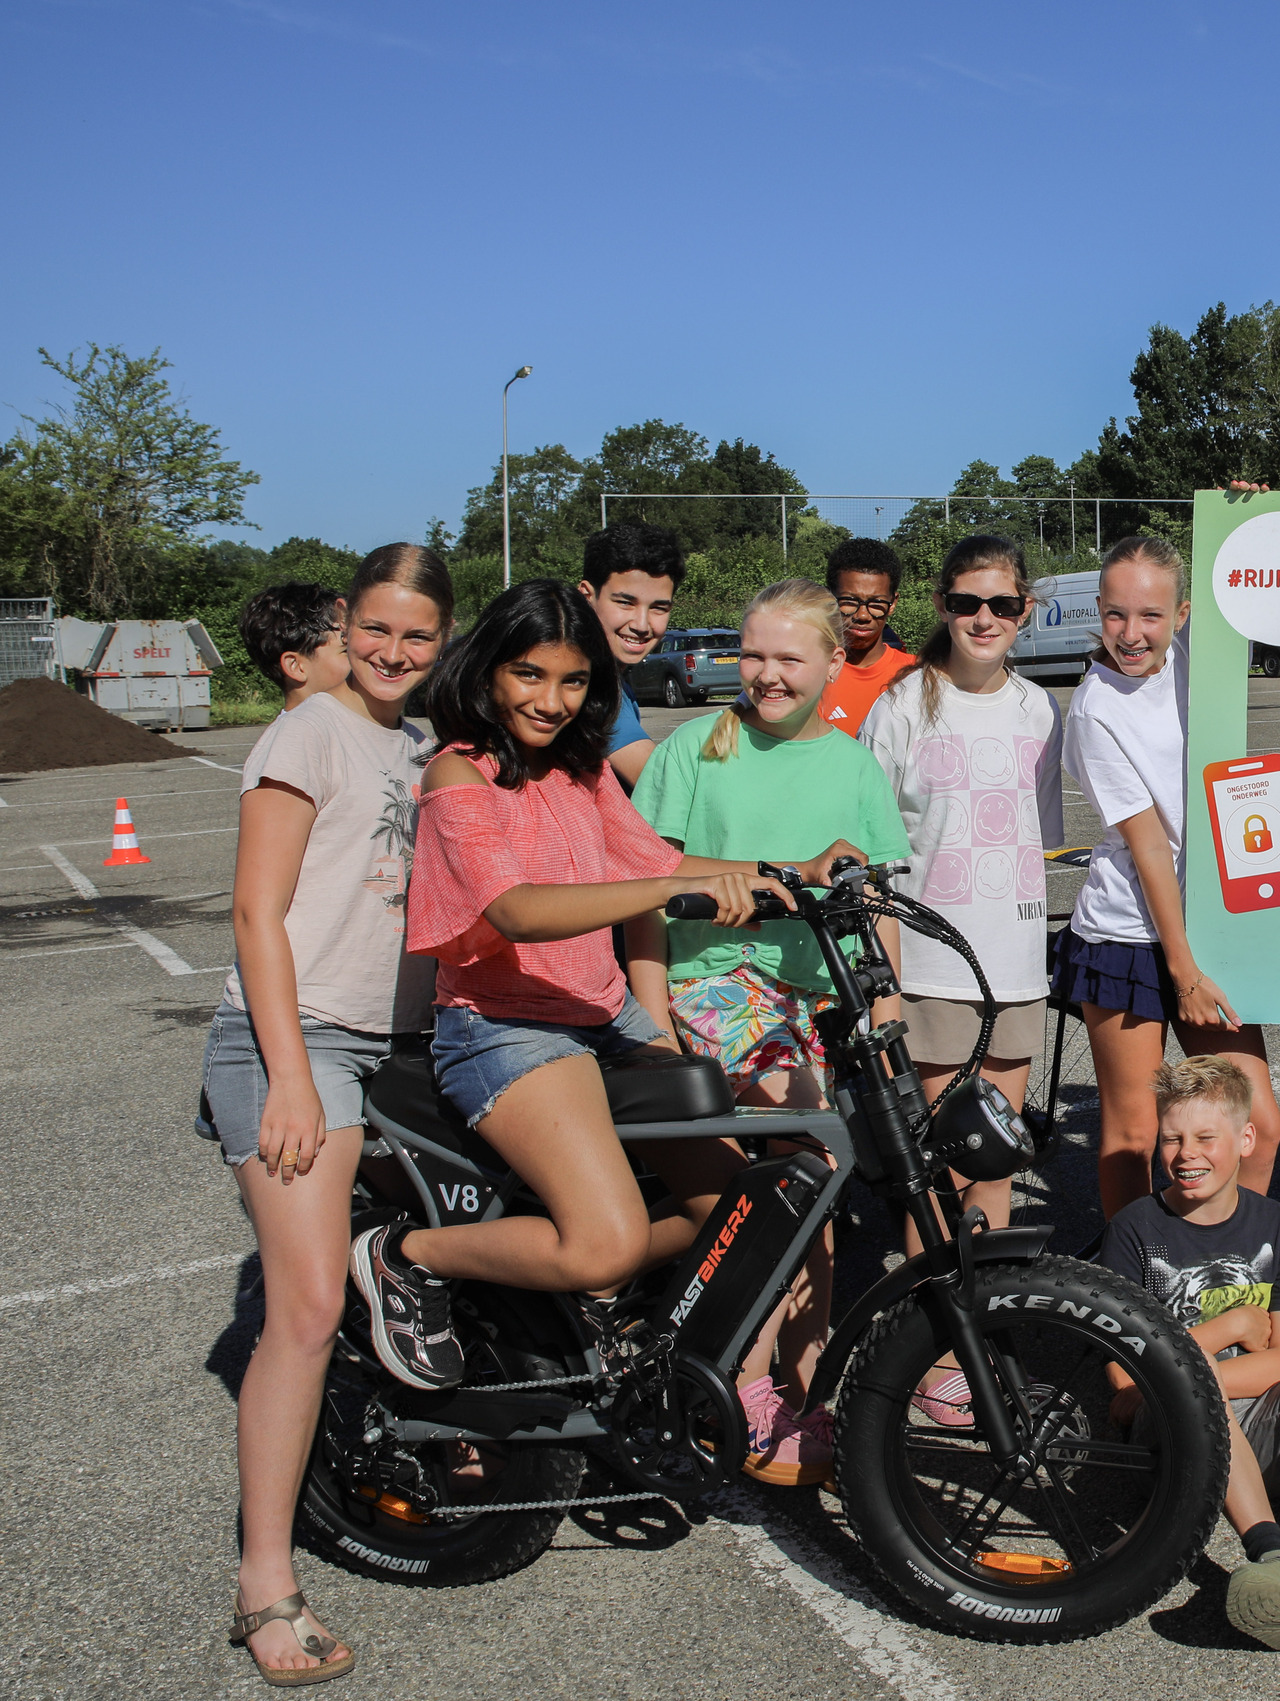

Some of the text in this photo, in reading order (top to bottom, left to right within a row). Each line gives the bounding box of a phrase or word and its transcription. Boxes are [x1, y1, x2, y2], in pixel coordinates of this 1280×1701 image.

[133, 647, 172, 659] SPELT
[1226, 780, 1270, 794] ONGESTOORD
[1231, 789, 1268, 801] ONDERWEG
[438, 1183, 480, 1213] V8
[669, 1194, 753, 1327] FASTBIKERZ
[987, 1294, 1148, 1357] KENDA
[750, 1386, 770, 1400] adidas
[336, 1535, 411, 1573] KRUSADE
[921, 1572, 934, 1584] BEAD
[946, 1591, 1042, 1624] KRUSADE
